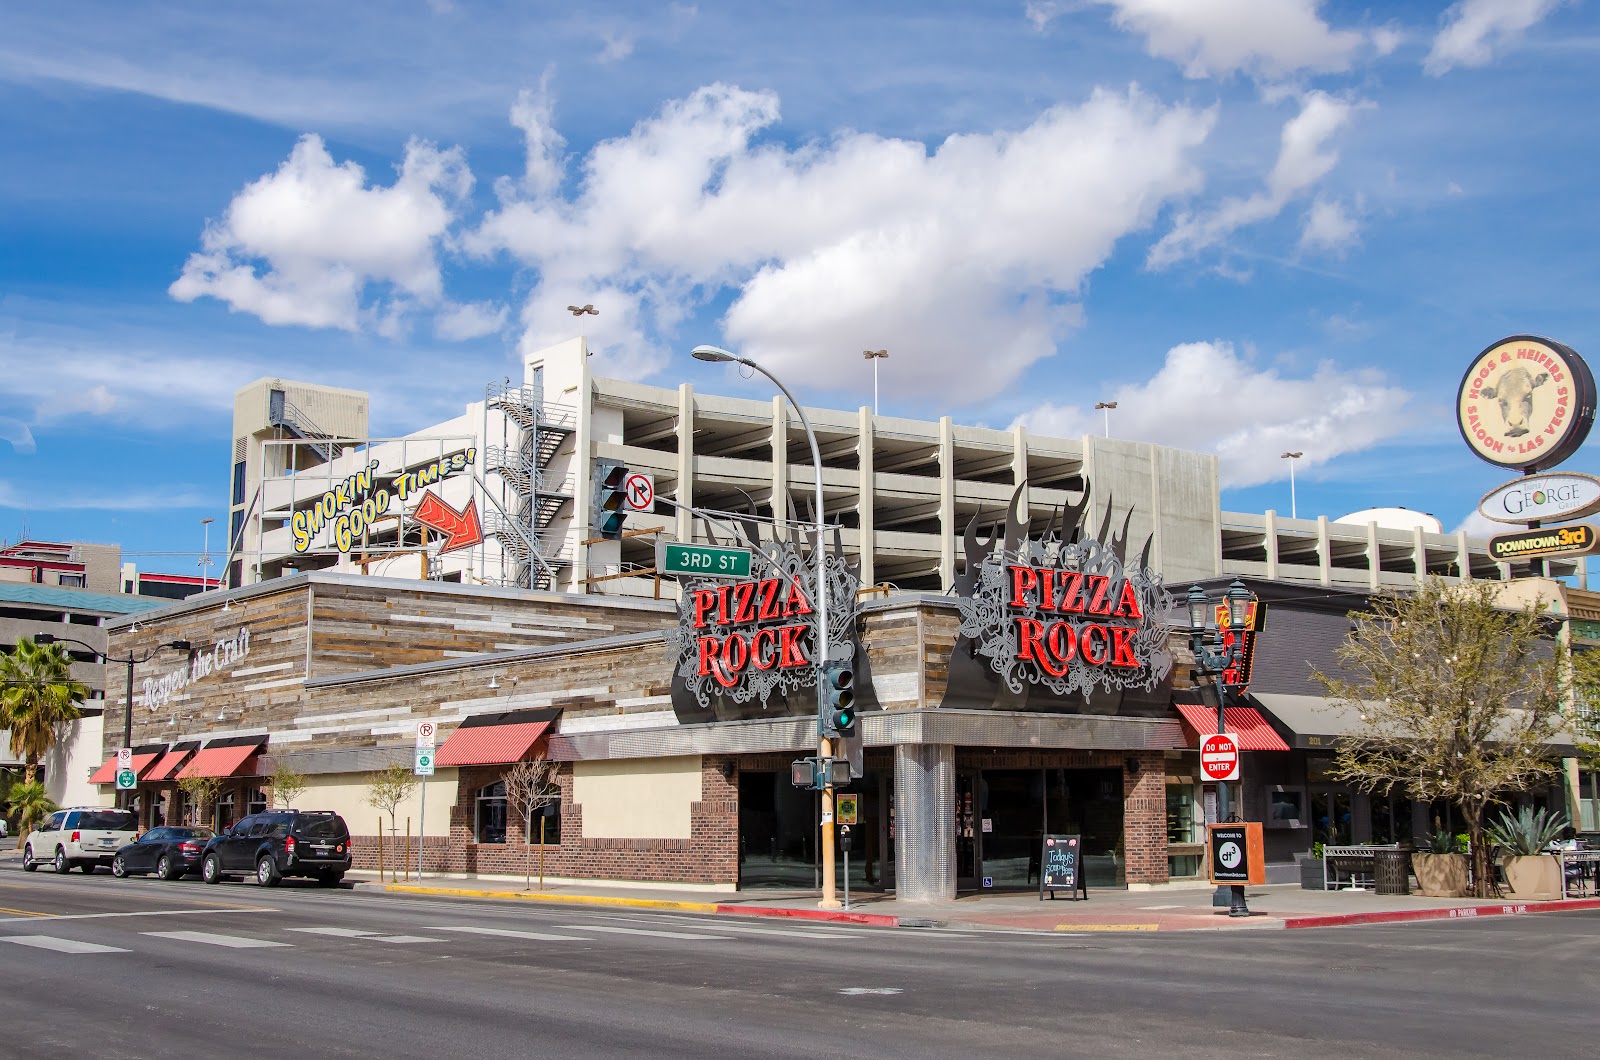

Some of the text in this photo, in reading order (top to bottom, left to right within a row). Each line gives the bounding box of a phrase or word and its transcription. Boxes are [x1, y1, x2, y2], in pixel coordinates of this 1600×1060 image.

[1469, 349, 1564, 399] HOGS & HEIFERS
[1468, 406, 1504, 453] SALOON
[1519, 387, 1568, 454] LAS VEGAS
[335, 448, 476, 552] GOOD TIMES!
[1503, 484, 1580, 514] GEORGE
[680, 552, 738, 570] 3RD ST
[692, 575, 812, 628] PIZZA
[1008, 565, 1143, 618] PIZZA
[142, 627, 251, 711] Respect the Craft
[697, 625, 809, 687] ROCK
[1016, 618, 1141, 677] ROCK
[1205, 743, 1232, 751] DO NOT
[1208, 763, 1230, 771] ENTER
[1048, 848, 1074, 867] Today's
[1503, 906, 1514, 914] FIRE
